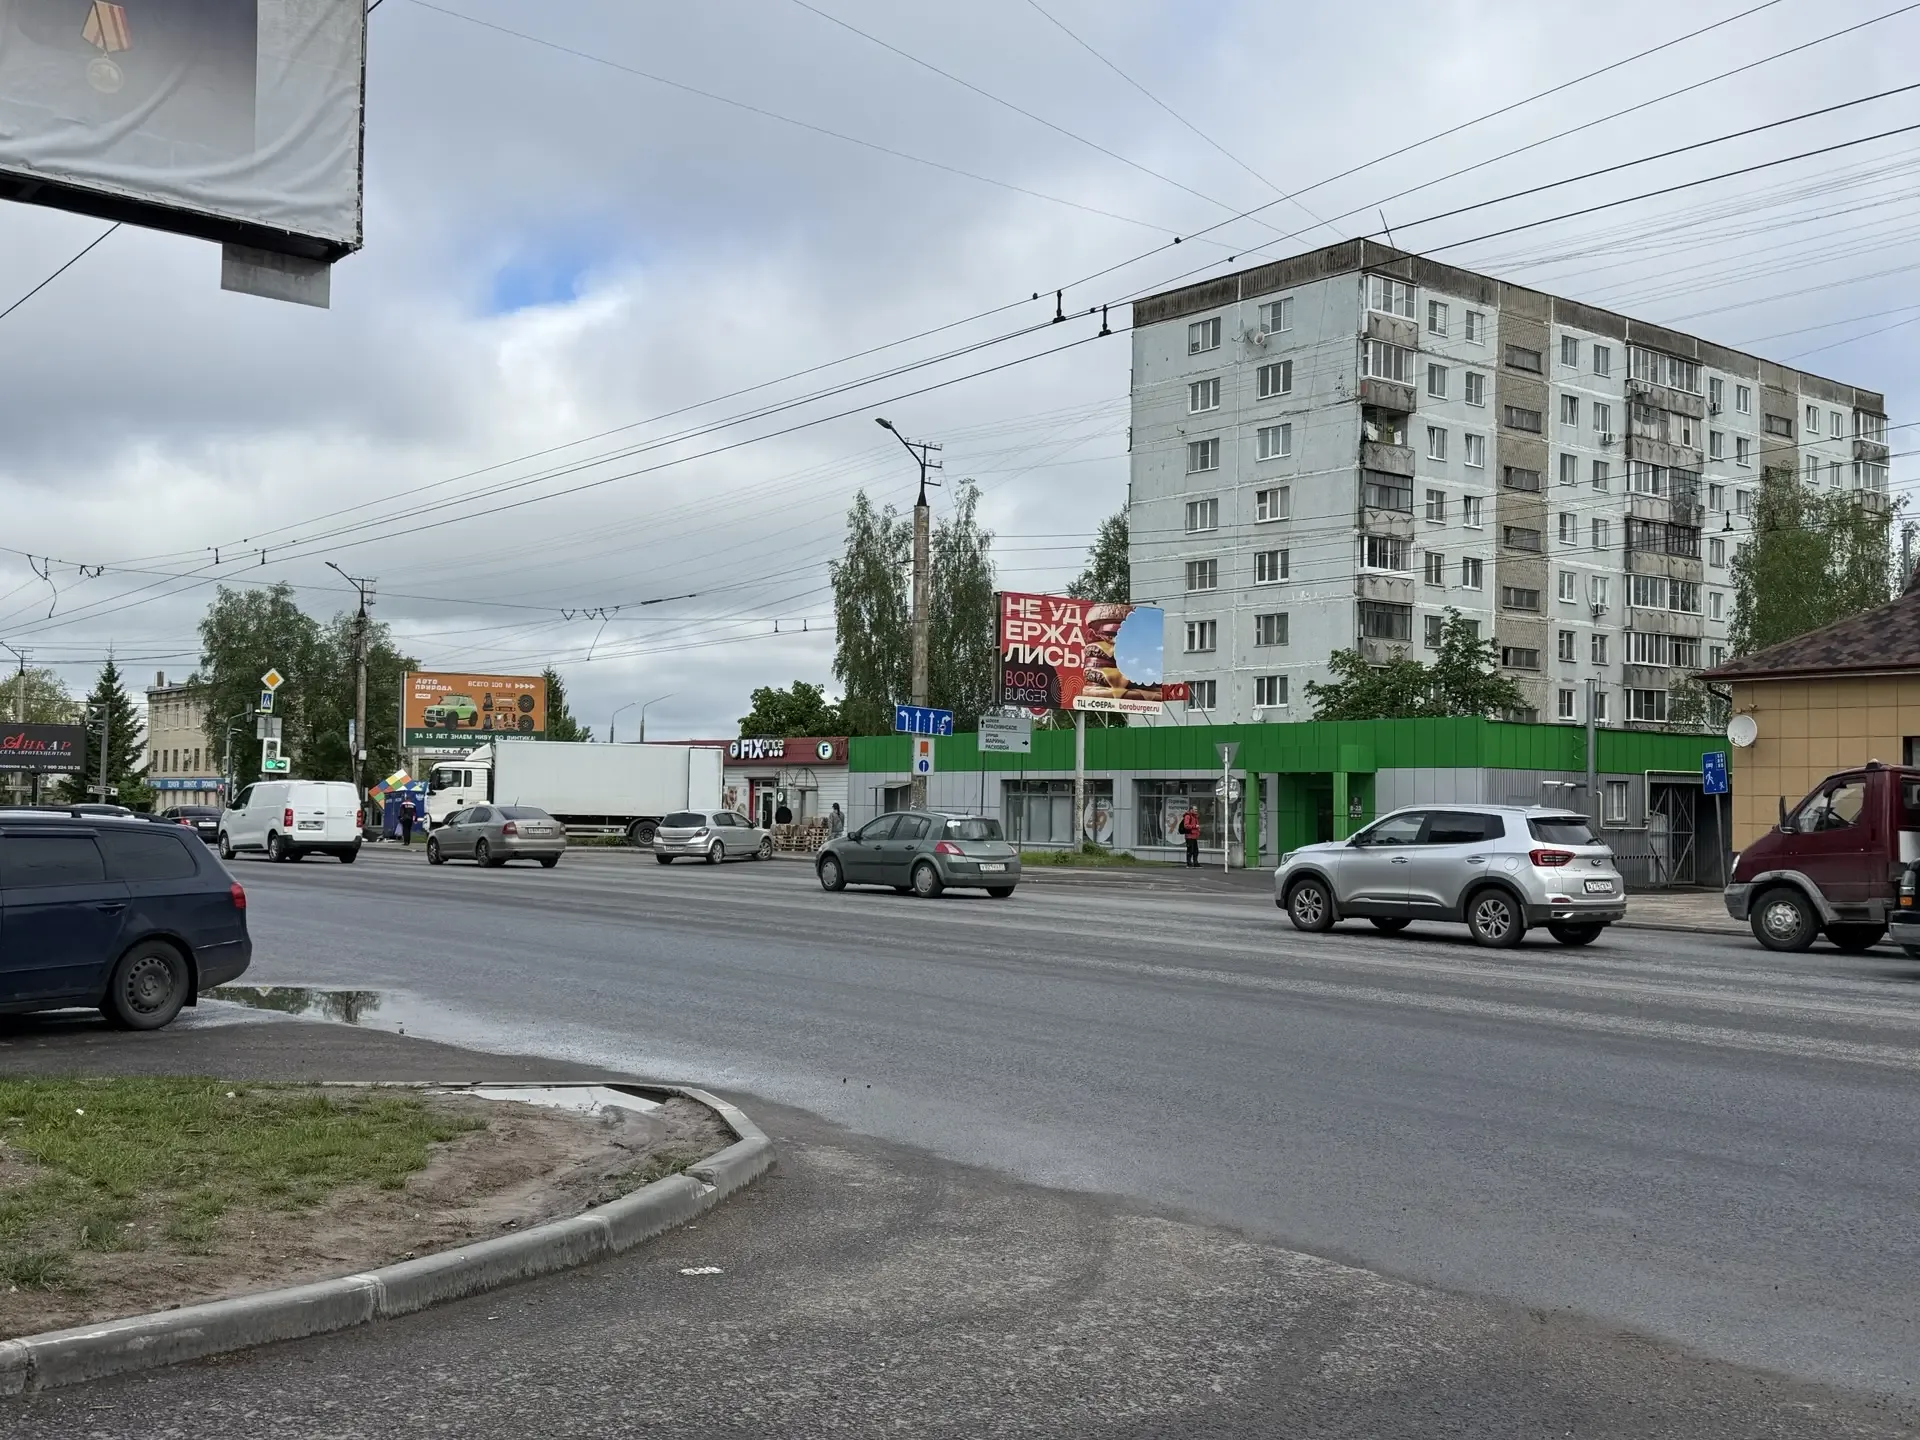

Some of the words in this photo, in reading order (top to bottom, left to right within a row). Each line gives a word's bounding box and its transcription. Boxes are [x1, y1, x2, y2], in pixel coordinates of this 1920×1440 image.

[1006, 597, 1042, 619] НЕ
[1048, 601, 1082, 627] УД
[1005, 620, 1085, 647] ЕРЖА
[1005, 642, 1085, 668] ЛИСЬ!
[467, 680, 489, 688] ВСЕГО
[1005, 670, 1048, 689] BORO
[1005, 687, 1048, 703] BURGER
[1077, 699, 1086, 709] ТЦ
[1088, 700, 1115, 710] «СФЕРА»
[1118, 702, 1160, 714] boroburger.ru
[741, 739, 764, 759] FIX
[762, 739, 784, 752] price
